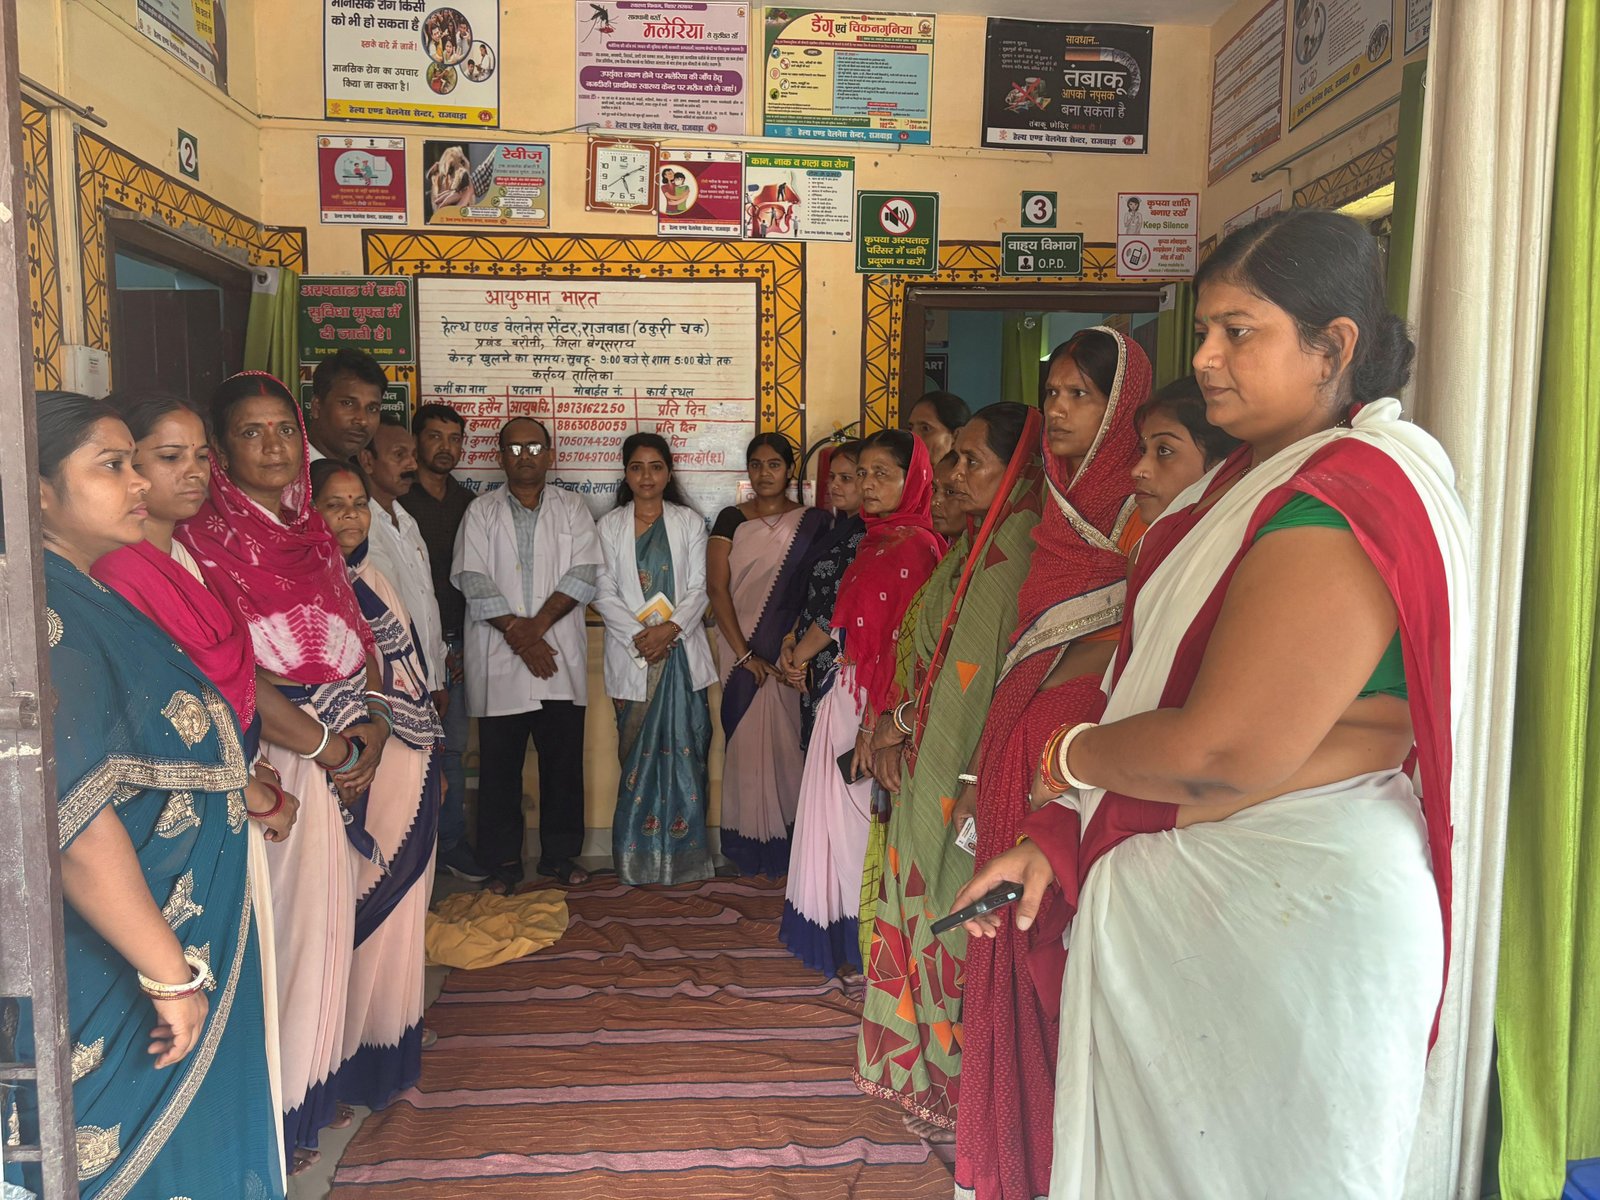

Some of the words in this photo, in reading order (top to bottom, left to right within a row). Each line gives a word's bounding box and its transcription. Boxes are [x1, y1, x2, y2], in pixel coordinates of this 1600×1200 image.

[331, 12, 346, 26] को
[348, 13, 361, 27] भी
[363, 14, 375, 28] हो
[377, 18, 409, 30] सकता
[411, 16, 420, 31] है
[643, 16, 705, 39] मलेरिया
[811, 13, 836, 38] डेंगू
[835, 22, 847, 33] एवं
[849, 20, 913, 36] चिकनगुनिया
[332, 62, 364, 73] मानसिक
[366, 64, 381, 74] रोग
[383, 67, 392, 75] का
[394, 68, 419, 77] उपचार
[342, 77, 361, 88] किया
[364, 80, 373, 88] जा
[376, 81, 398, 90] सकता
[1063, 63, 1128, 95] तंबाकू
[1061, 86, 1087, 99] आपको
[1061, 104, 1081, 116] बना
[1083, 105, 1115, 118] सकता
[1118, 101, 1126, 118] है
[185, 142, 193, 169] 2
[774, 158, 792, 166] नाक
[801, 159, 819, 168] गला
[821, 160, 833, 168] का
[834, 158, 849, 169] रोग
[1033, 198, 1047, 221] 3
[1147, 199, 1170, 209] कृपया
[1143, 221, 1161, 230] Keep
[1162, 221, 1189, 229] Silence
[863, 236, 890, 246] कृपया
[891, 237, 931, 245] अस्पताल
[1041, 237, 1077, 250] विभाग
[866, 244, 894, 254] परिसर
[895, 246, 905, 254] में
[867, 257, 895, 268] प्रदूषण
[1038, 258, 1067, 269] O.P.D.
[301, 284, 360, 297] अस्पताल
[362, 281, 377, 297] में
[377, 281, 407, 297] सभी
[485, 290, 551, 310] आयुष्मान
[561, 290, 601, 310] भारत
[308, 302, 351, 324] सुविधा
[387, 303, 403, 318] में
[319, 324, 335, 340] दी
[337, 324, 372, 340] जाती
[441, 315, 471, 337] हेल्थ
[474, 321, 499, 333] एण्ड
[504, 316, 544, 337] वेलनेस
[552, 335, 582, 350] जिला
[448, 349, 476, 366] केन्द्र
[479, 350, 512, 367] खुलने
[515, 354, 529, 363] का
[600, 355, 620, 364] 9:00
[641, 351, 650, 367] से
[651, 355, 671, 366] शाम
[674, 355, 695, 365] 5:00
[716, 356, 733, 366] तक
[925, 361, 944, 370] ART
[571, 367, 613, 383] तालिका
[433, 380, 454, 394] कर्मी
[455, 385, 466, 394] का
[468, 385, 488, 394] नाम
[511, 385, 543, 395] पदनाम
[573, 384, 609, 397] मोबाईल
[646, 385, 668, 396] कार्य
[670, 387, 695, 397] स्थल
[557, 402, 625, 414] 9973162250
[657, 399, 681, 417] प्रति
[684, 399, 706, 417] दिन
[557, 420, 627, 432] 8863080059
[655, 420, 675, 434] प्रति
[679, 420, 697, 433] दिन
[558, 436, 622, 447] 7050744290
[670, 434, 688, 448] दिन
[558, 451, 623, 463] 9570497004
